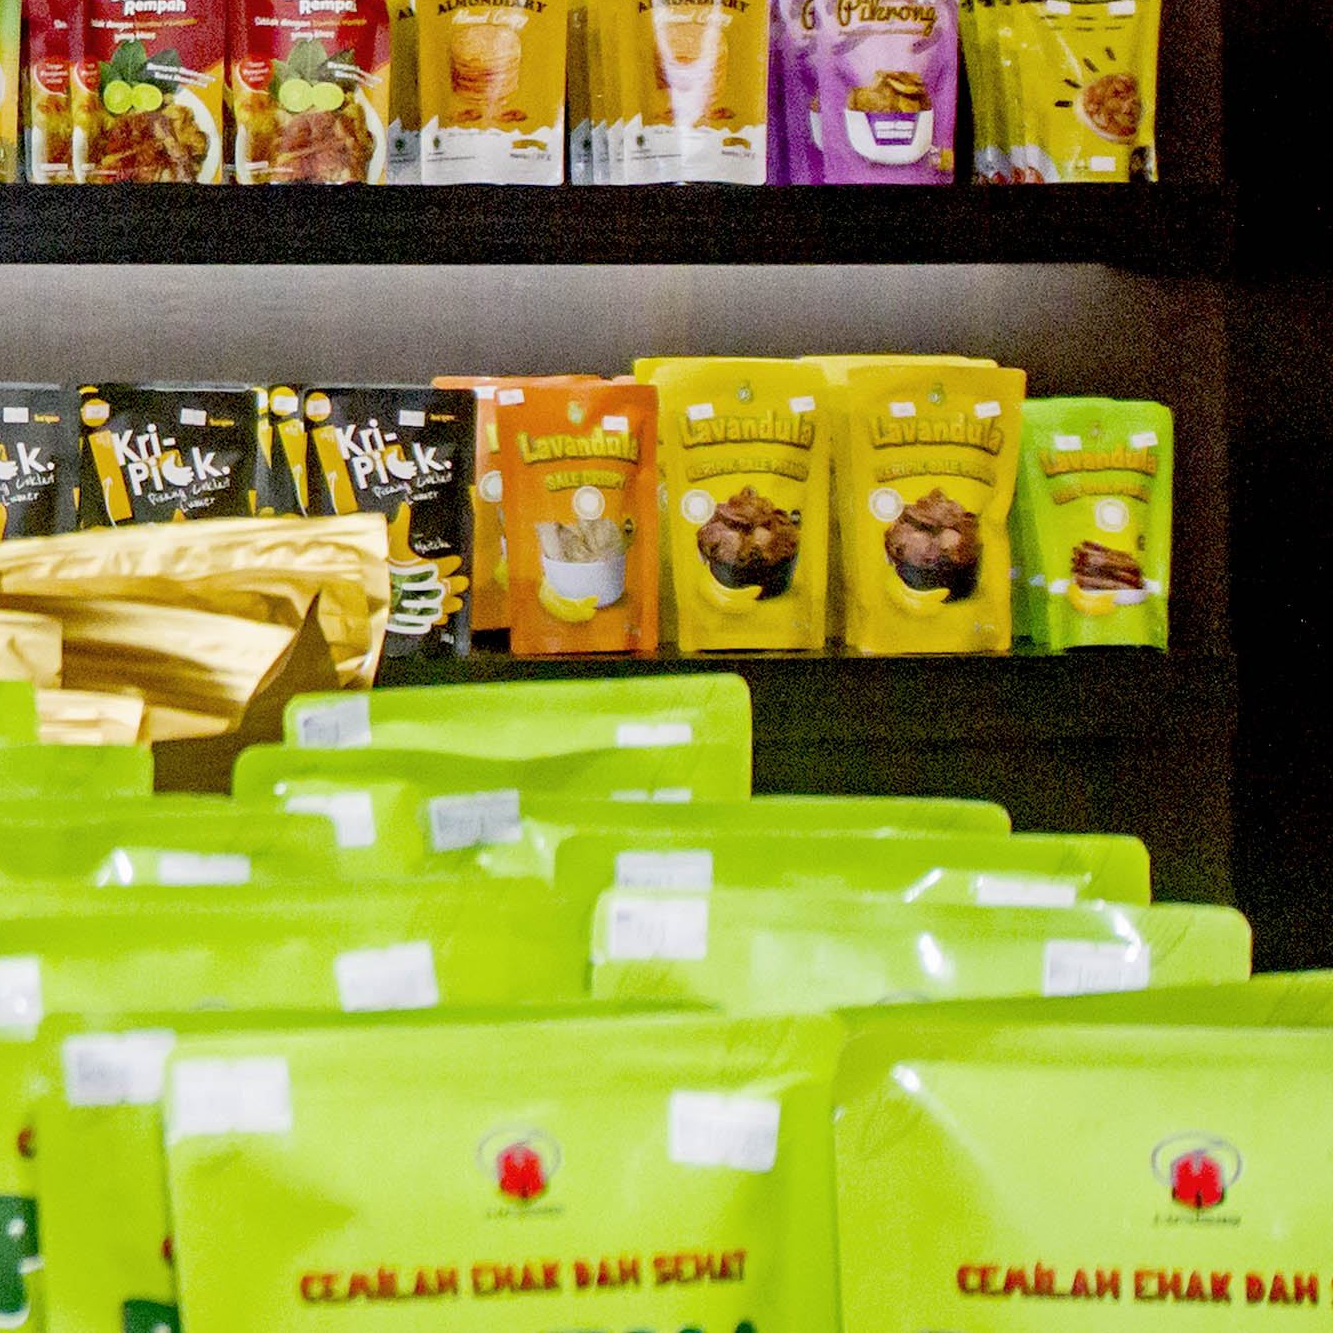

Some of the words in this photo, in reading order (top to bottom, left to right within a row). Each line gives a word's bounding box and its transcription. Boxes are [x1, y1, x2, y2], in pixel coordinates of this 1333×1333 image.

[112, 424, 176, 466] Kri-
[335, 418, 397, 460] Kri-
[517, 426, 638, 465] Lavandula
[681, 410, 814, 450] Lavandula
[869, 412, 1004, 456] Lavandula
[1038, 443, 1157, 477] Lavandula
